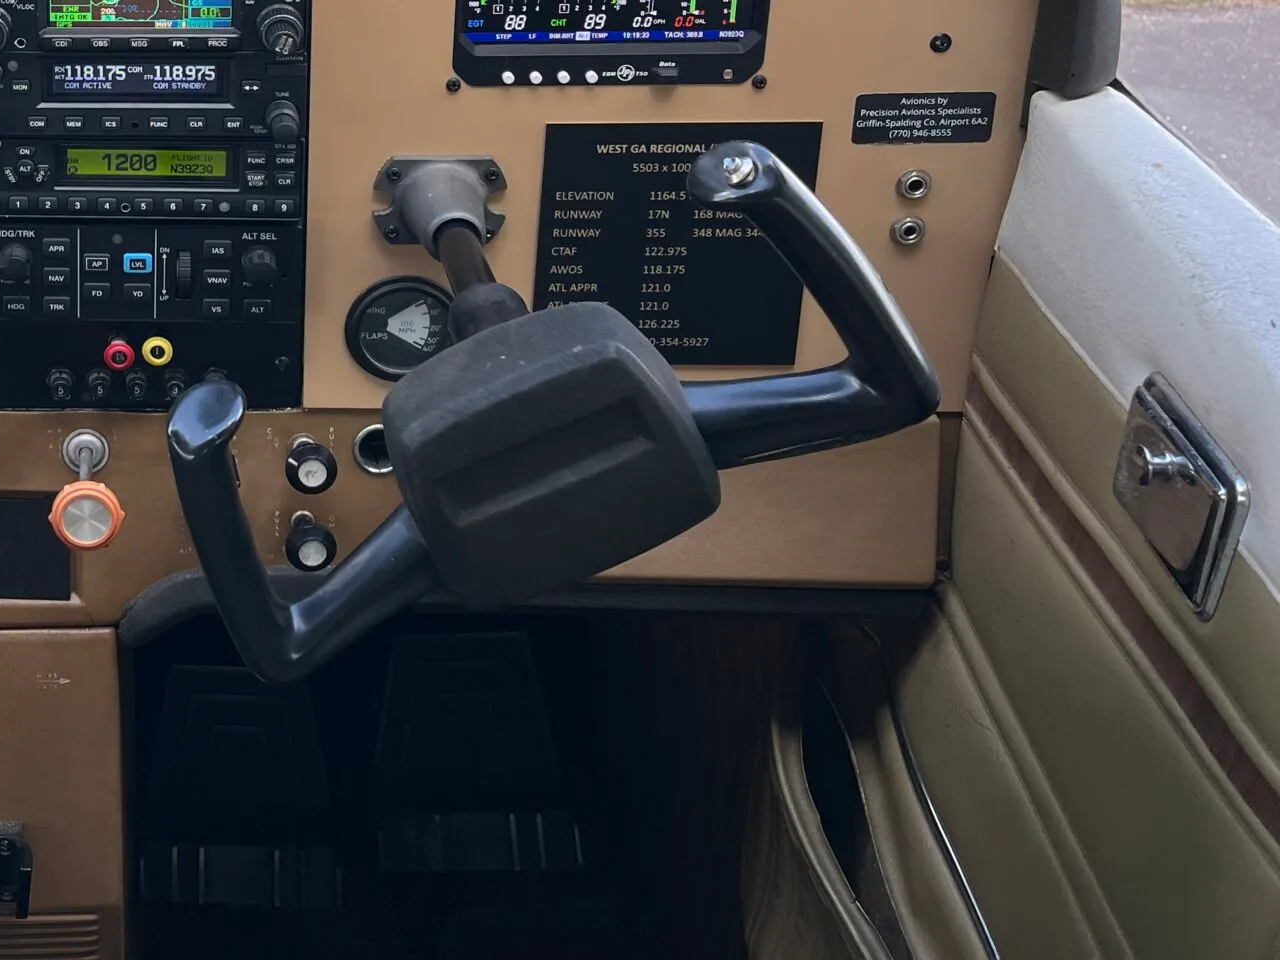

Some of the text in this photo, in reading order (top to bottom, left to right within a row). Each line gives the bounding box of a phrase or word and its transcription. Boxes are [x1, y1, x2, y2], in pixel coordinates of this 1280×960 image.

[504, 15, 527, 30] 88
[551, 19, 567, 27] CHT
[584, 14, 606, 29] 89
[65, 65, 126, 80] 118.175
[154, 66, 216, 81] 118.975
[937, 97, 948, 106] by
[901, 108, 935, 116] Avionics
[937, 107, 982, 115] Specialists
[856, 119, 921, 128] Griffin-Spalding
[939, 118, 969, 127] Airport
[971, 117, 988, 125] 6A2
[889, 129, 952, 138] (770) 946-8555
[596, 144, 707, 154] WEST GA REGIONAL
[102, 154, 157, 171] 1200
[632, 163, 692, 173] 5503 x 100
[556, 191, 686, 201] ELEVATION 1164.5
[554, 209, 713, 220] RUNWAY 17N 168
[553, 228, 742, 238] RUNWAY 355 348 MAG
[551, 246, 687, 256] CTAF 122.975
[549, 265, 685, 274] AWOS 118.175
[548, 283, 671, 293] ATL APPR 121.0
[639, 302, 669, 311] 121.0
[638, 320, 680, 329] 126.225
